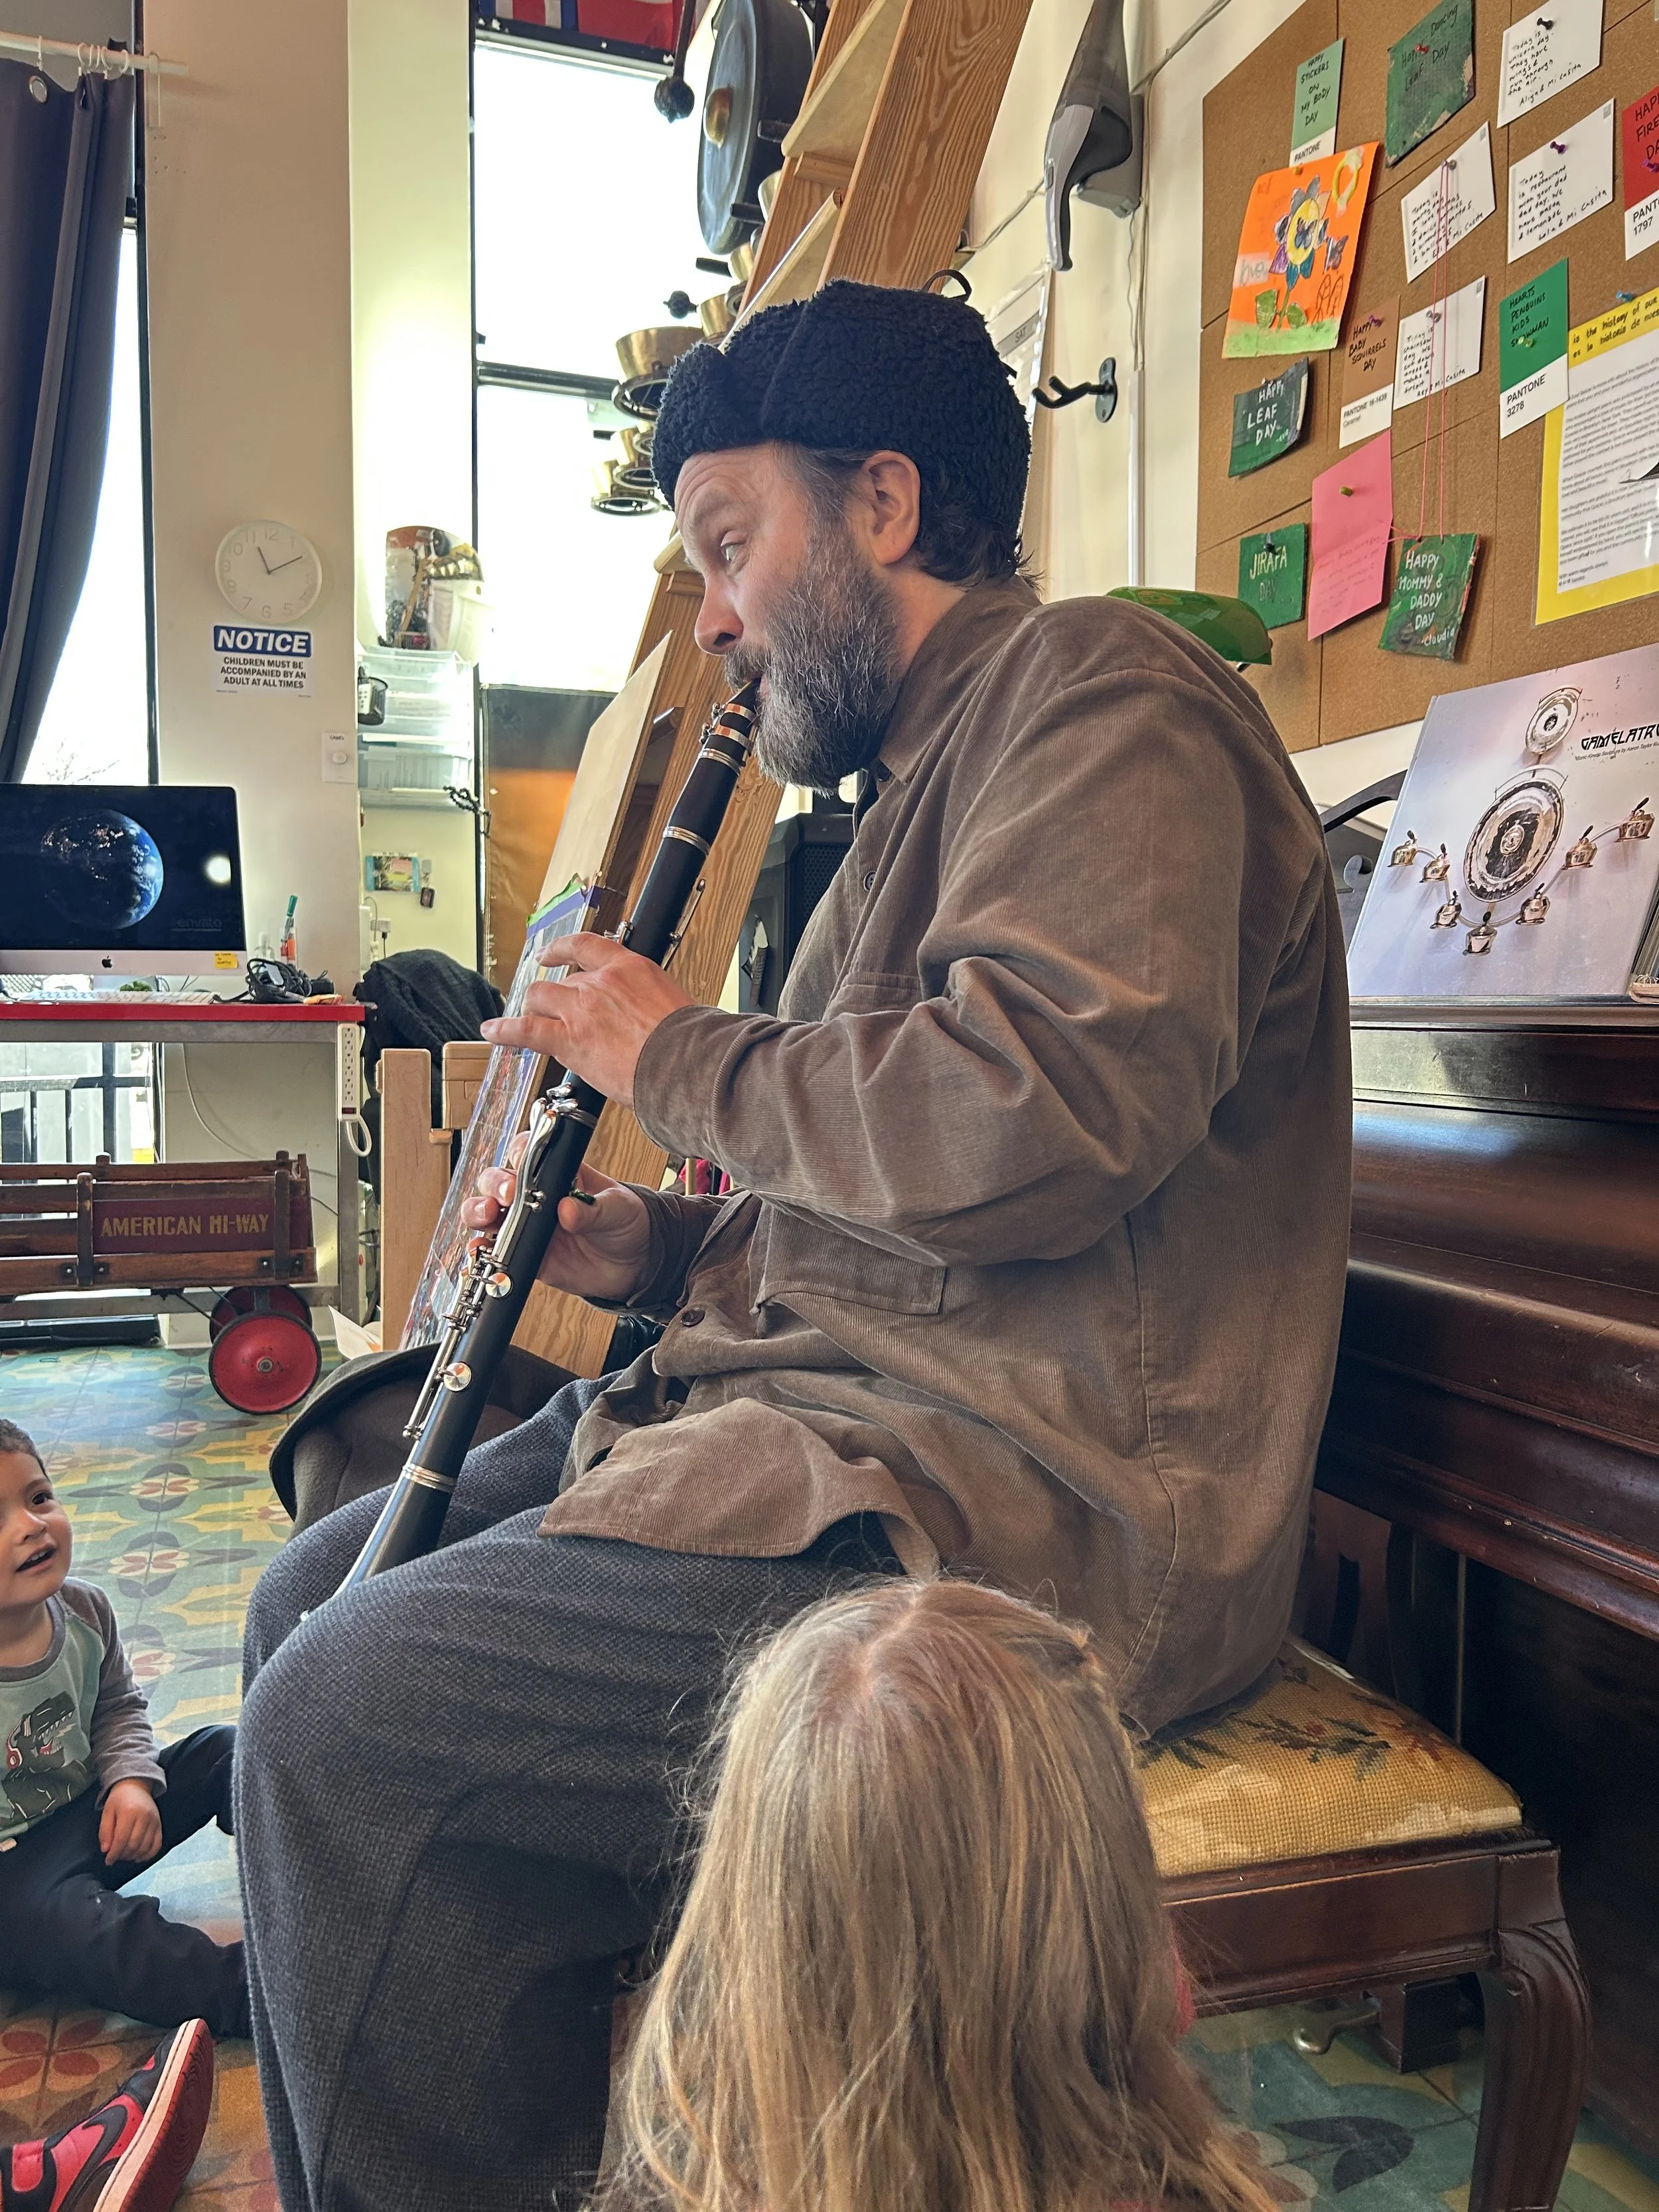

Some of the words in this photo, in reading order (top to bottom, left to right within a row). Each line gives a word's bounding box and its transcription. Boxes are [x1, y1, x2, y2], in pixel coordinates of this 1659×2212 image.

[1402, 39, 1424, 69] Hap
[1431, 4, 1458, 37] Dancing
[1512, 38, 1532, 51] Today
[1308, 52, 1325, 68] HAPPY
[1509, 46, 1534, 64] unicorn
[1531, 45, 1548, 59] have
[1301, 61, 1329, 84] STICKERS
[1406, 62, 1423, 92] Leaf
[1432, 41, 1450, 64] Day
[1509, 64, 1531, 82] wings
[1309, 82, 1319, 94] ON
[1508, 86, 1522, 96] the
[1510, 80, 1523, 89] run
[1301, 101, 1311, 113] MY
[1313, 86, 1331, 106] BODY
[1635, 93, 1659, 121] HAP
[1305, 110, 1319, 126] DAY
[1294, 140, 1321, 163] PANTONE
[1520, 171, 1544, 185] Today
[1530, 165, 1566, 191] restaurant
[1537, 185, 1551, 200] your
[1555, 173, 1567, 187] dad
[1518, 217, 1536, 230] have
[1540, 201, 1560, 217] pasta
[1519, 206, 1532, 218] dad
[1633, 198, 1659, 222] PANT
[1527, 208, 1561, 236] lemonade
[1634, 216, 1653, 236] 1797
[1510, 285, 1535, 309] HEARTS
[1511, 292, 1546, 323] PENGUINS
[1353, 320, 1372, 340] HAPPY
[1512, 315, 1530, 333] KIDS
[1573, 334, 1580, 344] is
[1586, 327, 1597, 338] the
[1602, 311, 1628, 330] history
[1632, 301, 1640, 315] of
[1600, 325, 1626, 344] historia
[1630, 318, 1640, 329] de
[1348, 338, 1366, 357] BABY
[1352, 338, 1386, 365] SQUIRRELS
[1363, 357, 1376, 372] DAY
[1259, 380, 1284, 403] HAPPY
[1506, 373, 1546, 405] PANTONE
[1247, 403, 1278, 429] LEAF
[1344, 401, 1368, 418] PANTONE
[1506, 400, 1525, 417] 3278
[1256, 419, 1277, 446] DAY
[1250, 546, 1287, 579] JIRAFA
[1405, 550, 1439, 571] HAPPY
[1398, 574, 1433, 591] MOMMY
[1435, 573, 1443, 589] &
[1410, 592, 1443, 610] DADDY
[261, 605, 271, 619] 6
[1415, 612, 1435, 630] DAY
[218, 628, 309, 654] NOTICE
[220, 666, 281, 678] ACCOMPANIED
[283, 670, 294, 678] BY
[224, 656, 265, 667] CHILDREN
[267, 659, 291, 668] MUST
[292, 661, 303, 670] BE
[224, 676, 250, 686] ADULT
[263, 679, 277, 688] ALL
[278, 680, 304, 689] TIMES
[177, 917, 222, 928] envato
[101, 1215, 201, 1237] AMERICAN
[209, 1214, 269, 1234] HI-WAY
